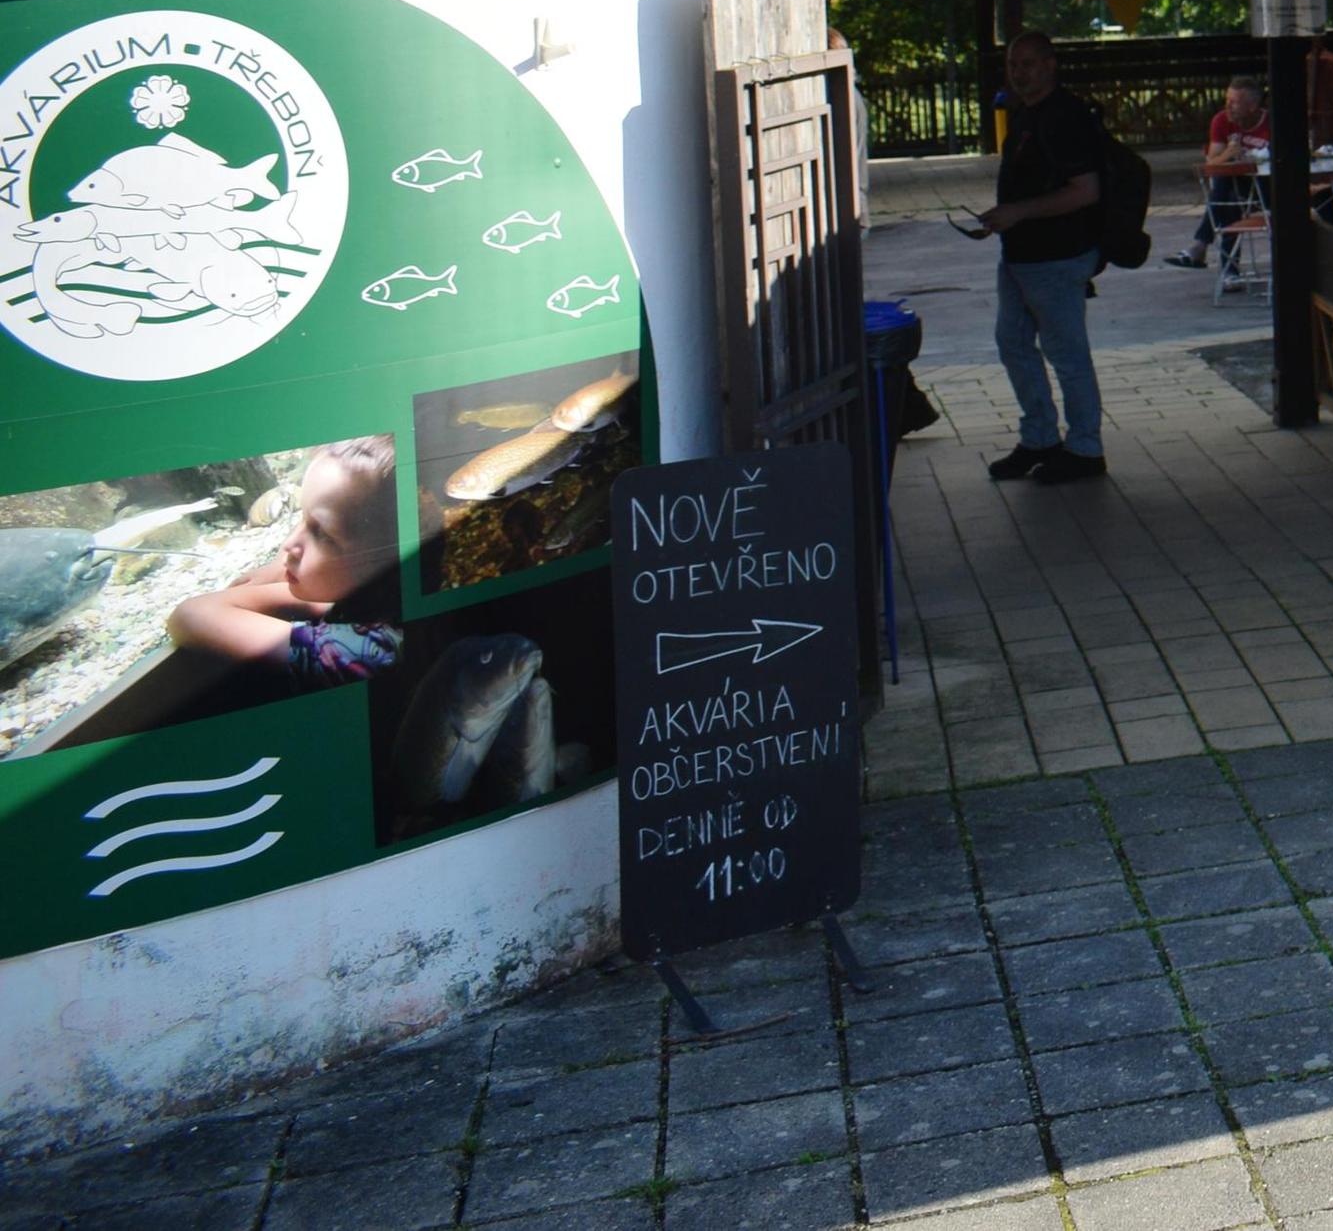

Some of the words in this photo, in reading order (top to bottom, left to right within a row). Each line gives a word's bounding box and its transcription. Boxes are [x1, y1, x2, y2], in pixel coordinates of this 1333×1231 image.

[0, 33, 171, 208] AKVÁRIUM
[211, 40, 324, 178] TŘEBOŇ
[631, 467, 768, 551] NOVĚ
[633, 542, 837, 604] OTEVŘENO
[639, 677, 795, 745] AKVÁRIA
[631, 701, 848, 801] OBČERSTVENÍ
[638, 791, 746, 861] DENNĚ
[764, 794, 798, 830] OD
[696, 847, 786, 901] 11:00
